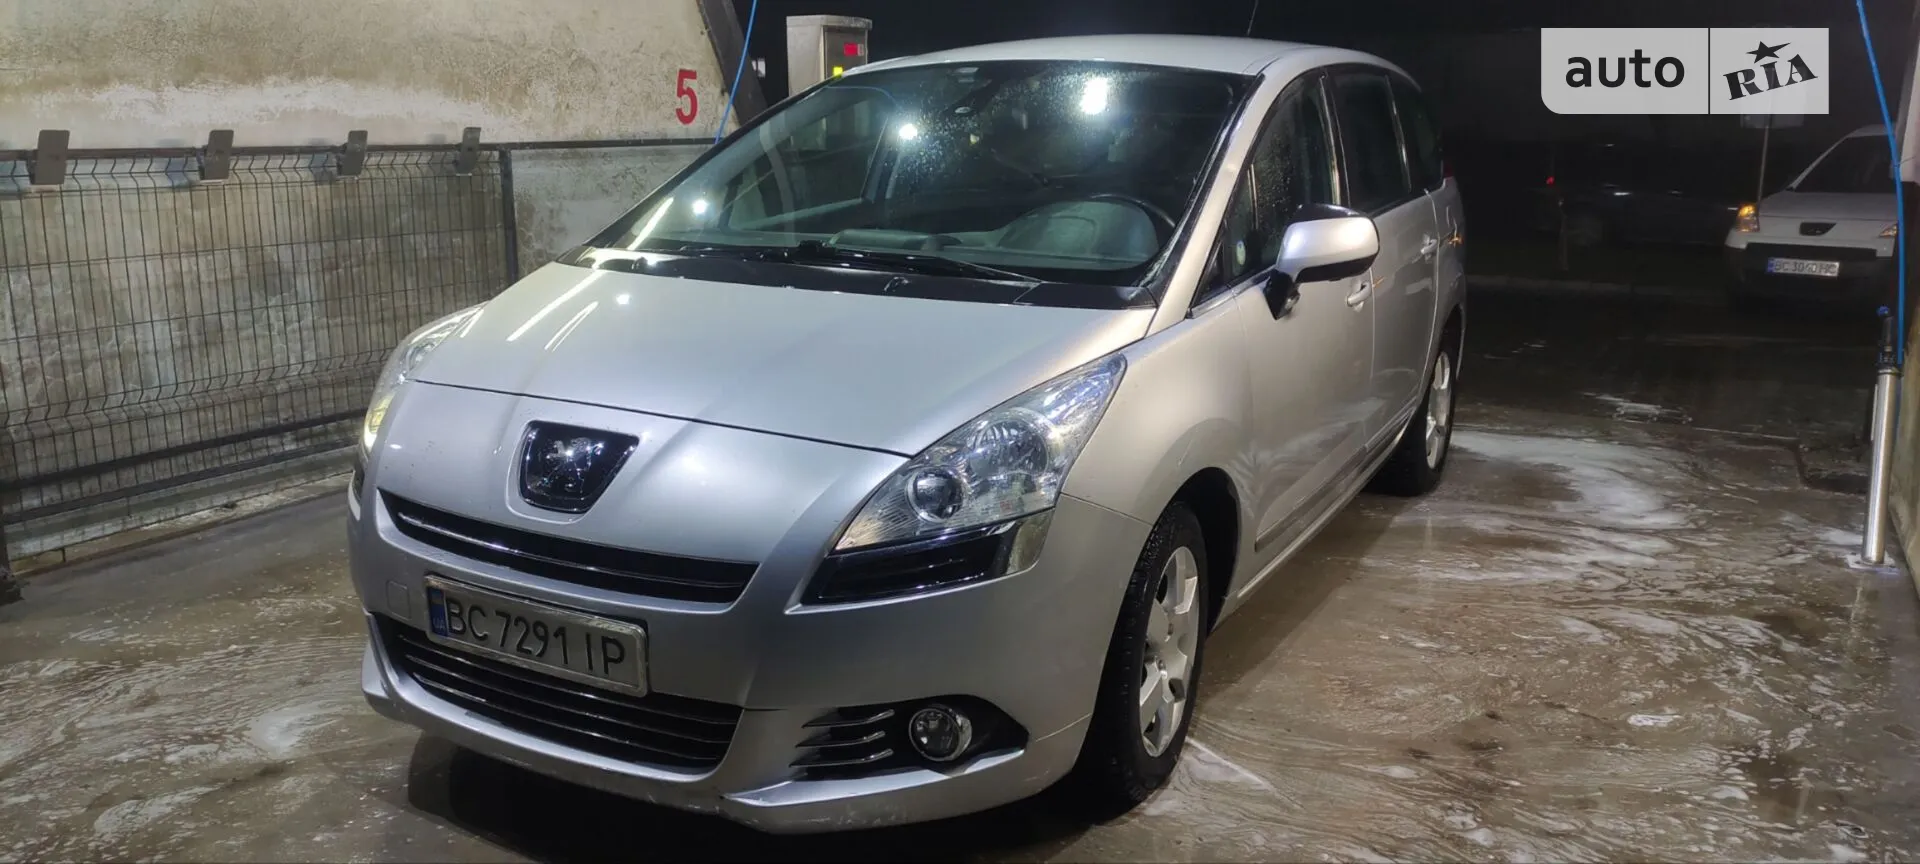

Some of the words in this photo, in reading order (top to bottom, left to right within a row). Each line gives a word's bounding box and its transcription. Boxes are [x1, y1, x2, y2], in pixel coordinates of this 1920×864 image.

[675, 68, 698, 125] 5
[446, 598, 489, 641] BC
[495, 610, 569, 665] 7291
[585, 632, 626, 675] IP
